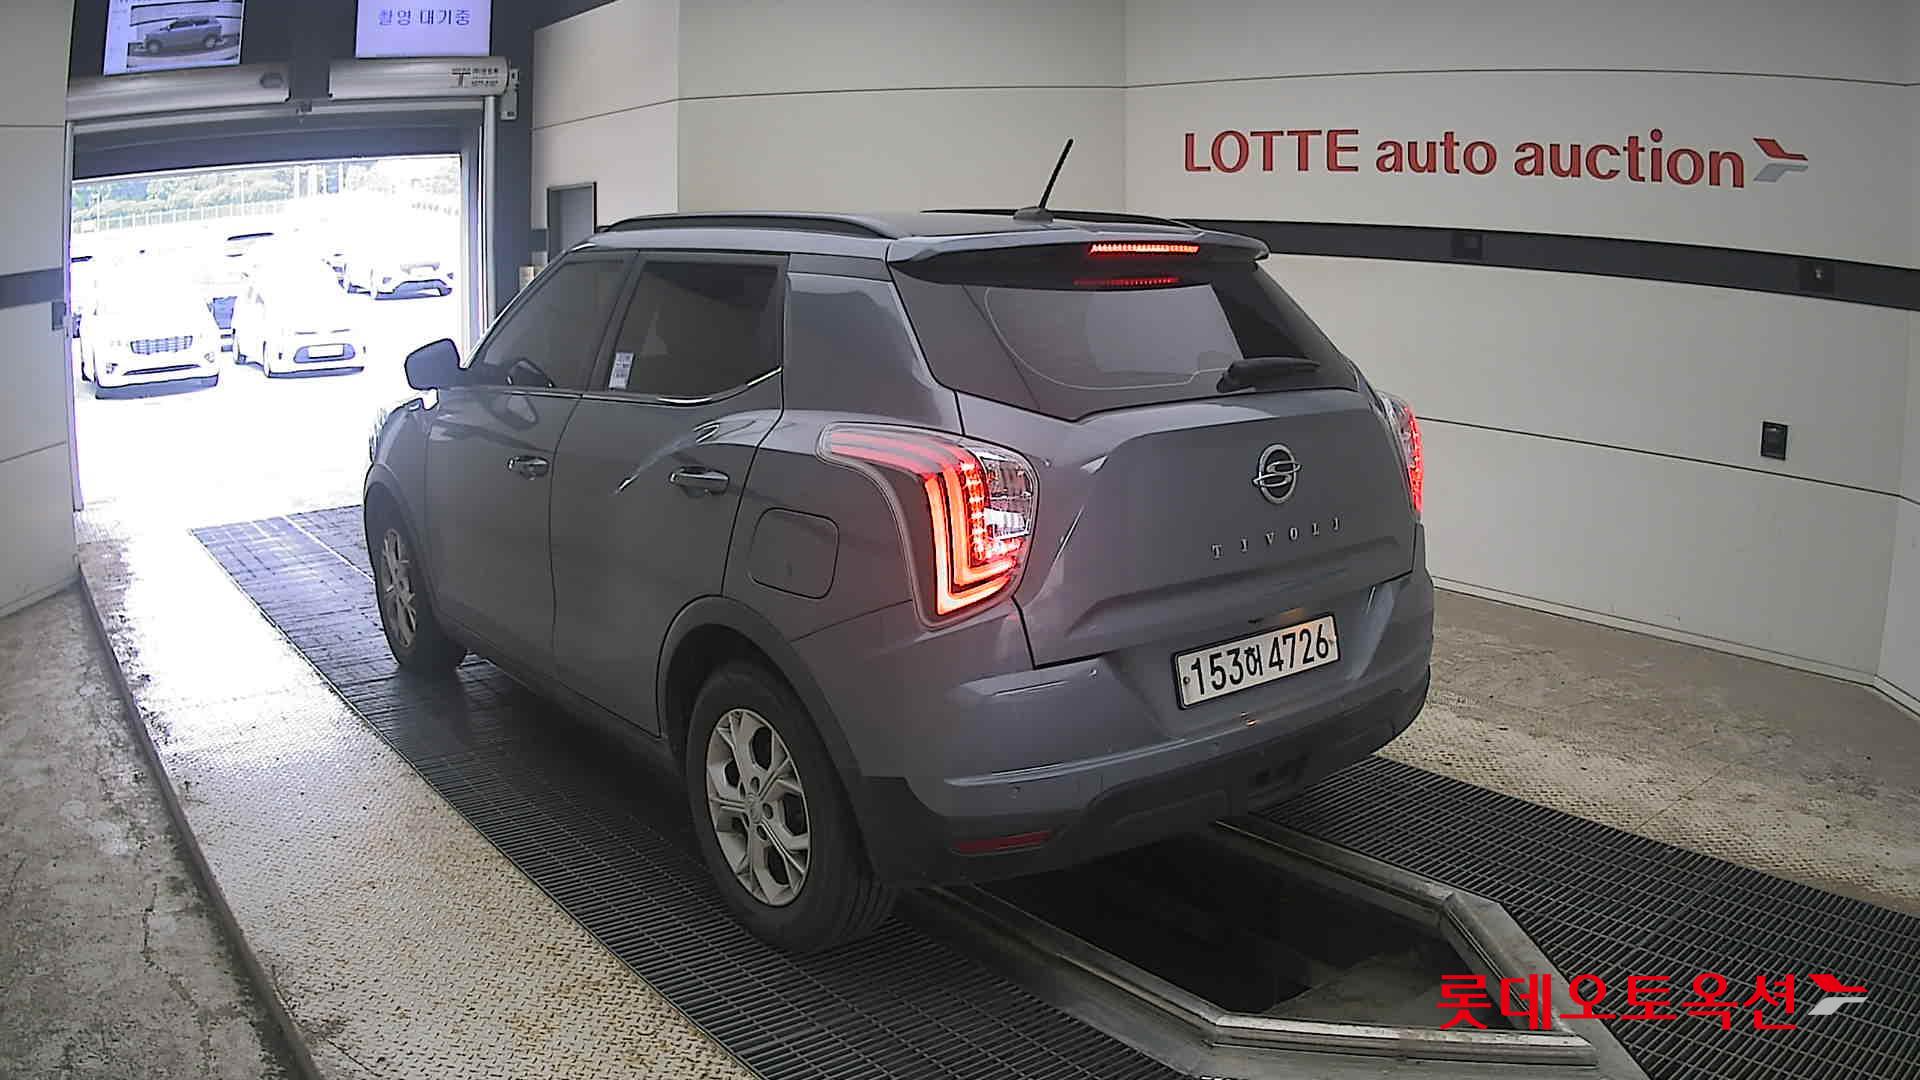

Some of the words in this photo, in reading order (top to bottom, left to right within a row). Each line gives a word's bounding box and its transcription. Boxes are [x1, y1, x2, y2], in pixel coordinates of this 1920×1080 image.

[420, 8, 471, 26] 대기중
[1184, 128, 1360, 173] LOTTE
[1376, 130, 1498, 176] auto
[1513, 128, 1746, 188] auction
[1211, 516, 1343, 560] TIVOLI
